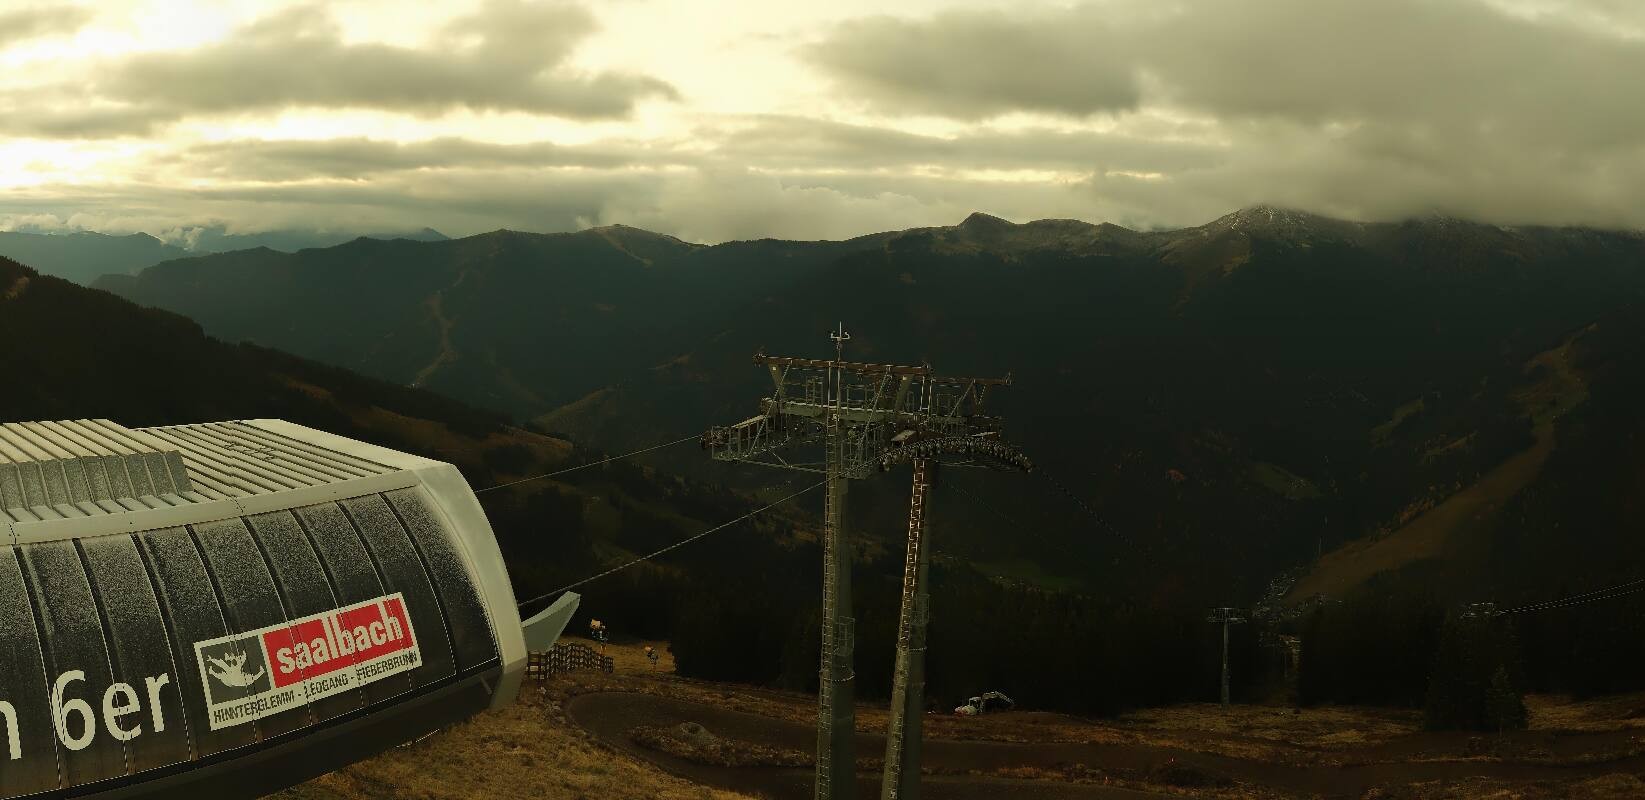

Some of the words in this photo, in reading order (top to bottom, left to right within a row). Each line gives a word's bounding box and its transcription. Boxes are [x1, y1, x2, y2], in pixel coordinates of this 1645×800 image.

[276, 601, 404, 675] saalbach
[52, 669, 170, 751] 6er
[304, 673, 350, 697] LEOGANG
